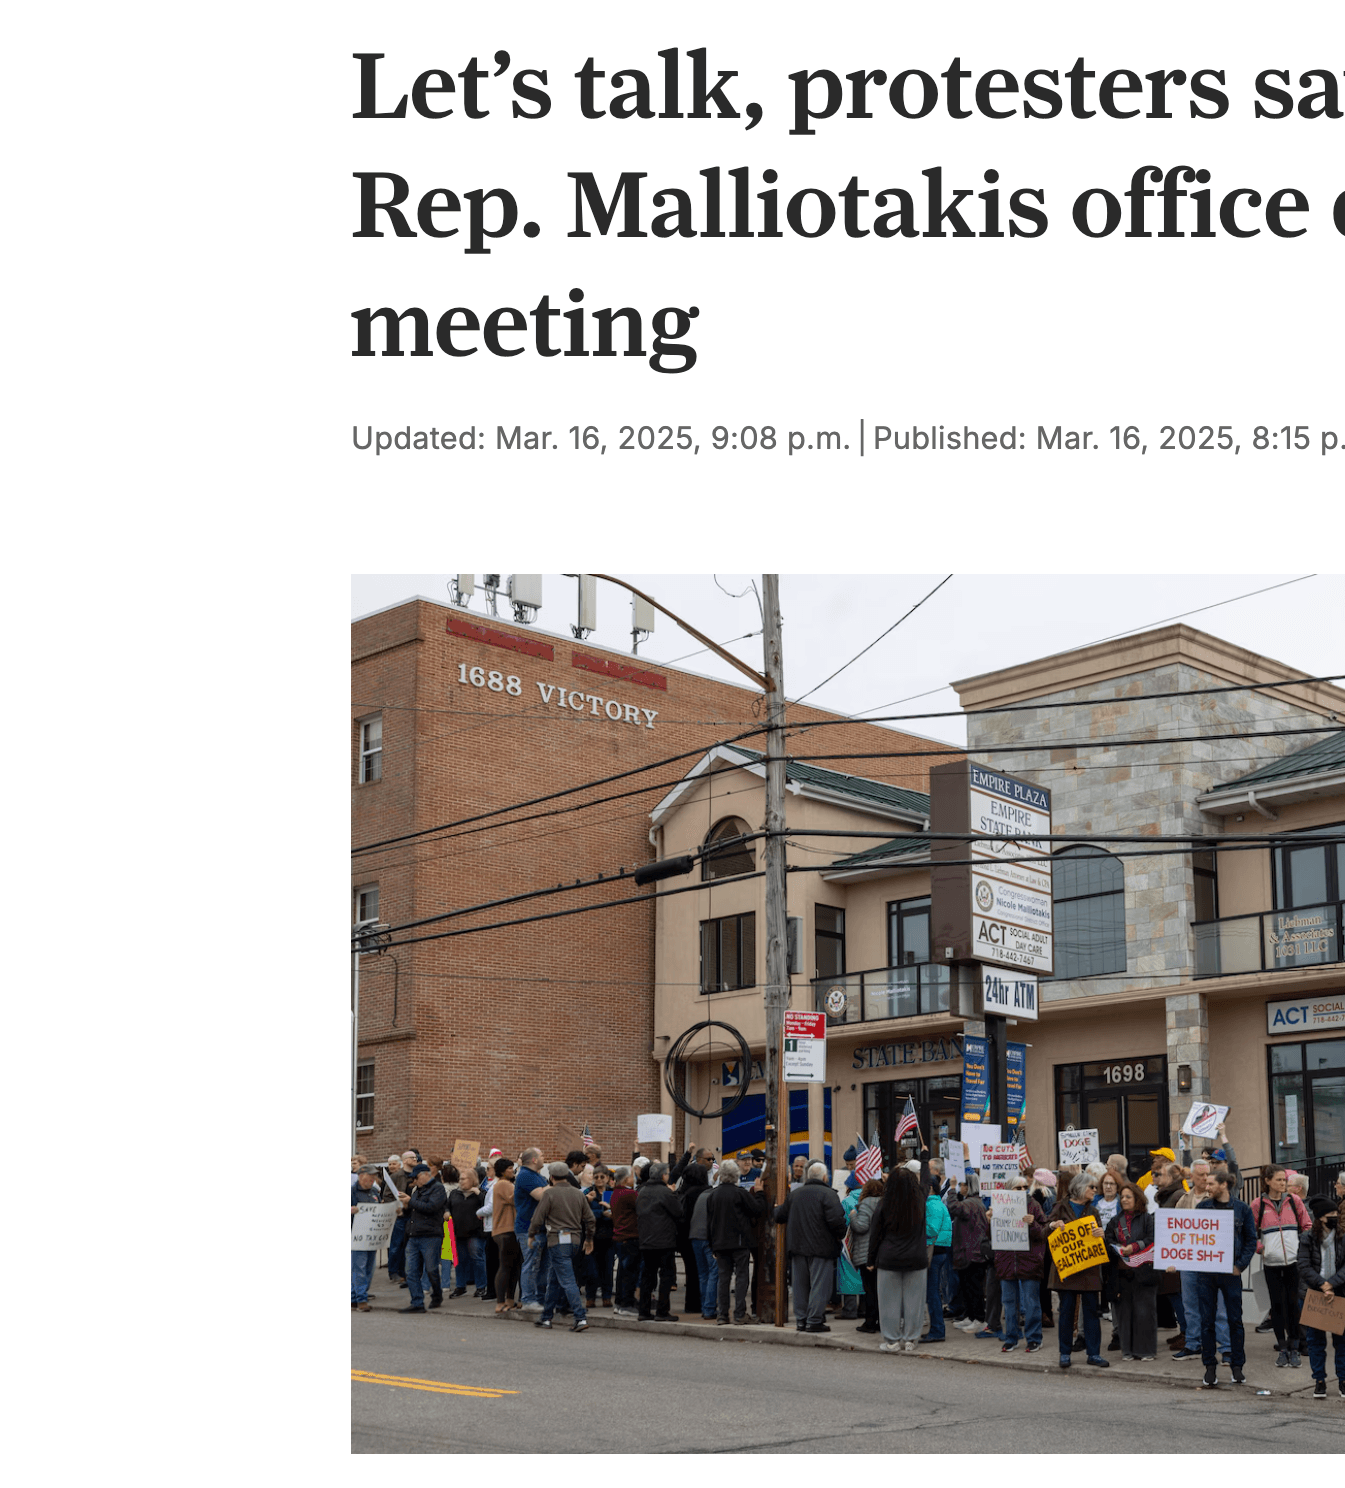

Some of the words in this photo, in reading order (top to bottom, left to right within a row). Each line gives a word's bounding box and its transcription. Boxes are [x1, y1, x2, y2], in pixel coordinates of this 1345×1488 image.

[458, 663, 522, 696] 1688
[536, 682, 659, 729] VICTORY
[973, 769, 1011, 795] EMPIRE
[1014, 784, 1048, 807] PLAZA
[990, 800, 1032, 827] EMPIRE
[998, 886, 1048, 907] Congresswoman
[996, 898, 1016, 910] Nicole
[1018, 903, 1050, 919] Malliotakis
[1278, 915, 1323, 930] Liebman
[979, 921, 1007, 945] ACT
[1009, 927, 1030, 940] SOCIAL
[1031, 933, 1048, 945] ADULT
[1269, 932, 1279, 944] &
[1282, 927, 1334, 943] Associates
[992, 948, 1035, 965] 718-442-7467
[1015, 941, 1026, 950] DAY
[1028, 943, 1043, 955] CARE
[1275, 943, 1301, 958] 1031
[1303, 939, 1328, 954] LLC
[985, 975, 1009, 1005] 24hr
[1014, 981, 1035, 1011] ATM
[1273, 1006, 1309, 1026] ACT
[1313, 1003, 1344, 1013] SOCIAL
[788, 1040, 793, 1051] 1
[852, 1044, 916, 1070] STATE
[921, 1038, 965, 1063] BAN
[1103, 1063, 1145, 1084] 1698
[1063, 1137, 1091, 1148] DOGE
[359, 1205, 377, 1214] SAVE
[1002, 1207, 1016, 1217] FOR
[992, 1217, 1011, 1228] TRUMP
[1167, 1217, 1219, 1230] ENOUGH
[996, 1229, 1028, 1243] ECONOMICS
[1171, 1233, 1186, 1245] OF
[1189, 1233, 1216, 1246] THIS
[1062, 1239, 1085, 1254] OUR
[1161, 1247, 1193, 1261] DOGE
[1196, 1250, 1225, 1263] SH-T
